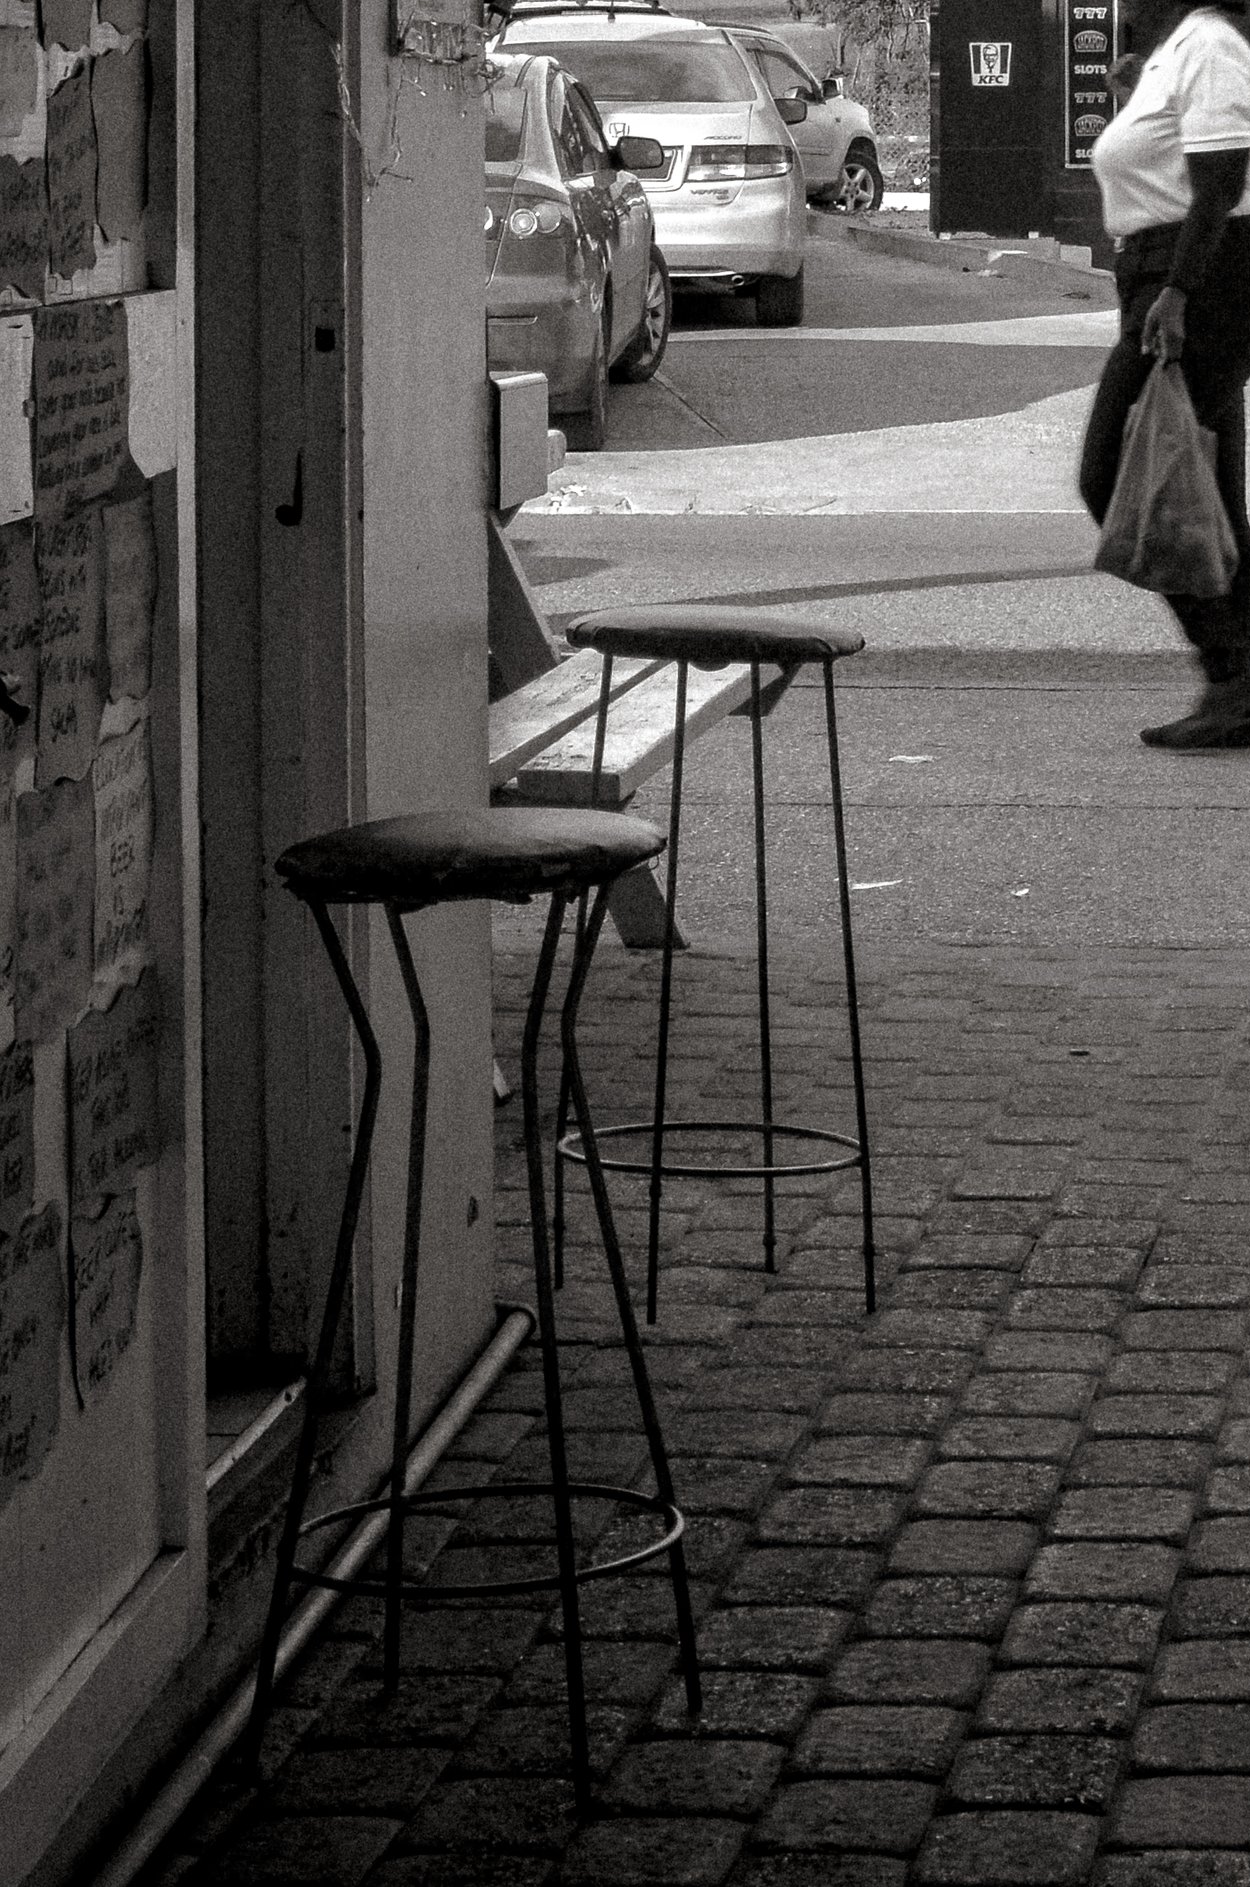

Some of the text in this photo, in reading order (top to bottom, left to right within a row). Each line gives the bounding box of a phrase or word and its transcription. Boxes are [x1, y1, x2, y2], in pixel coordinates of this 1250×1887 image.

[1073, 7, 1108, 20] 777
[1074, 64, 1108, 75] SLOTS
[977, 75, 1005, 85] KFC
[1075, 148, 1094, 159] SLO
